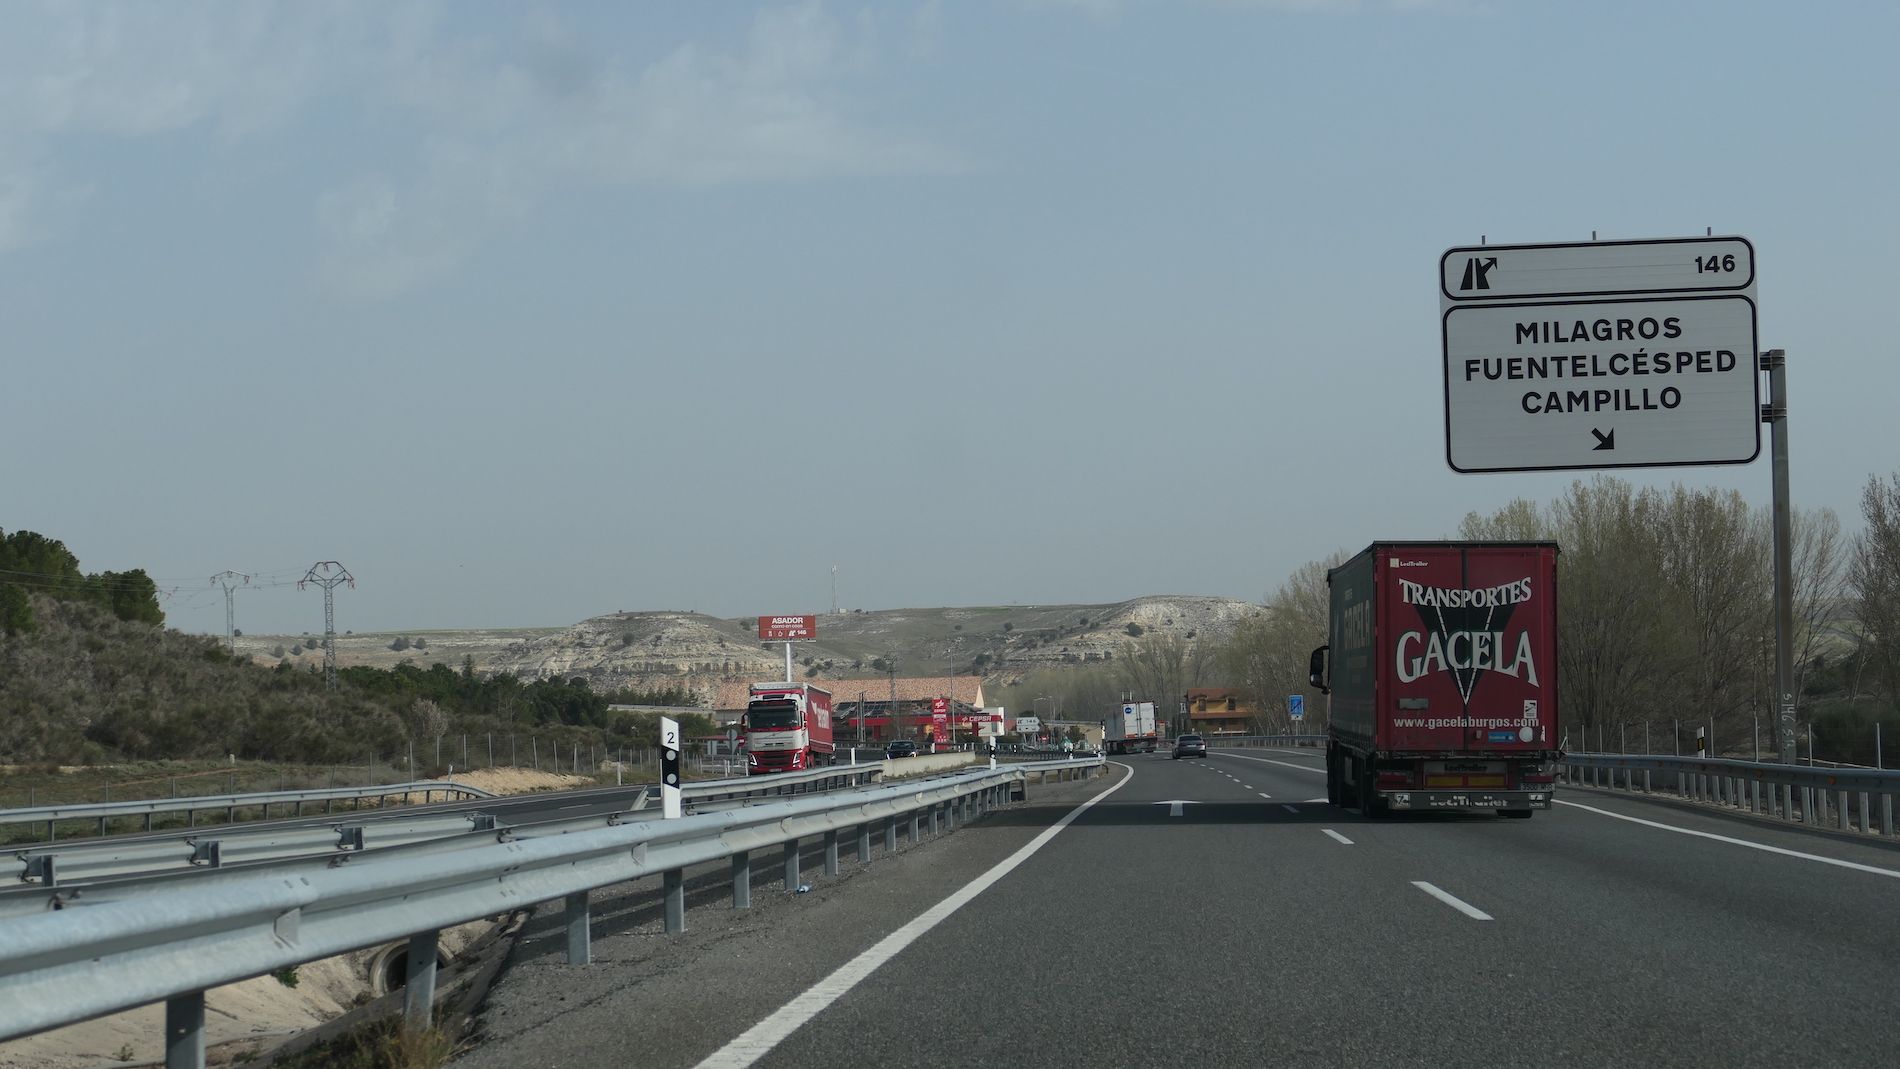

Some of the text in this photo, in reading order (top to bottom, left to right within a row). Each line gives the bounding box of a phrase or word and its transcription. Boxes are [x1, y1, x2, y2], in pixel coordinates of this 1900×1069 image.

[1694, 254, 1736, 274] 146
[1515, 316, 1682, 345] MILAGROS
[1464, 347, 1737, 382] FUENTELCÉSPED
[1521, 385, 1682, 414] CAMPILLO
[1398, 576, 1532, 609] TRANSPORTES
[1396, 630, 1540, 688] GACELA
[666, 731, 675, 744] 2
[1393, 716, 1540, 730] www.gacelaburgos.com
